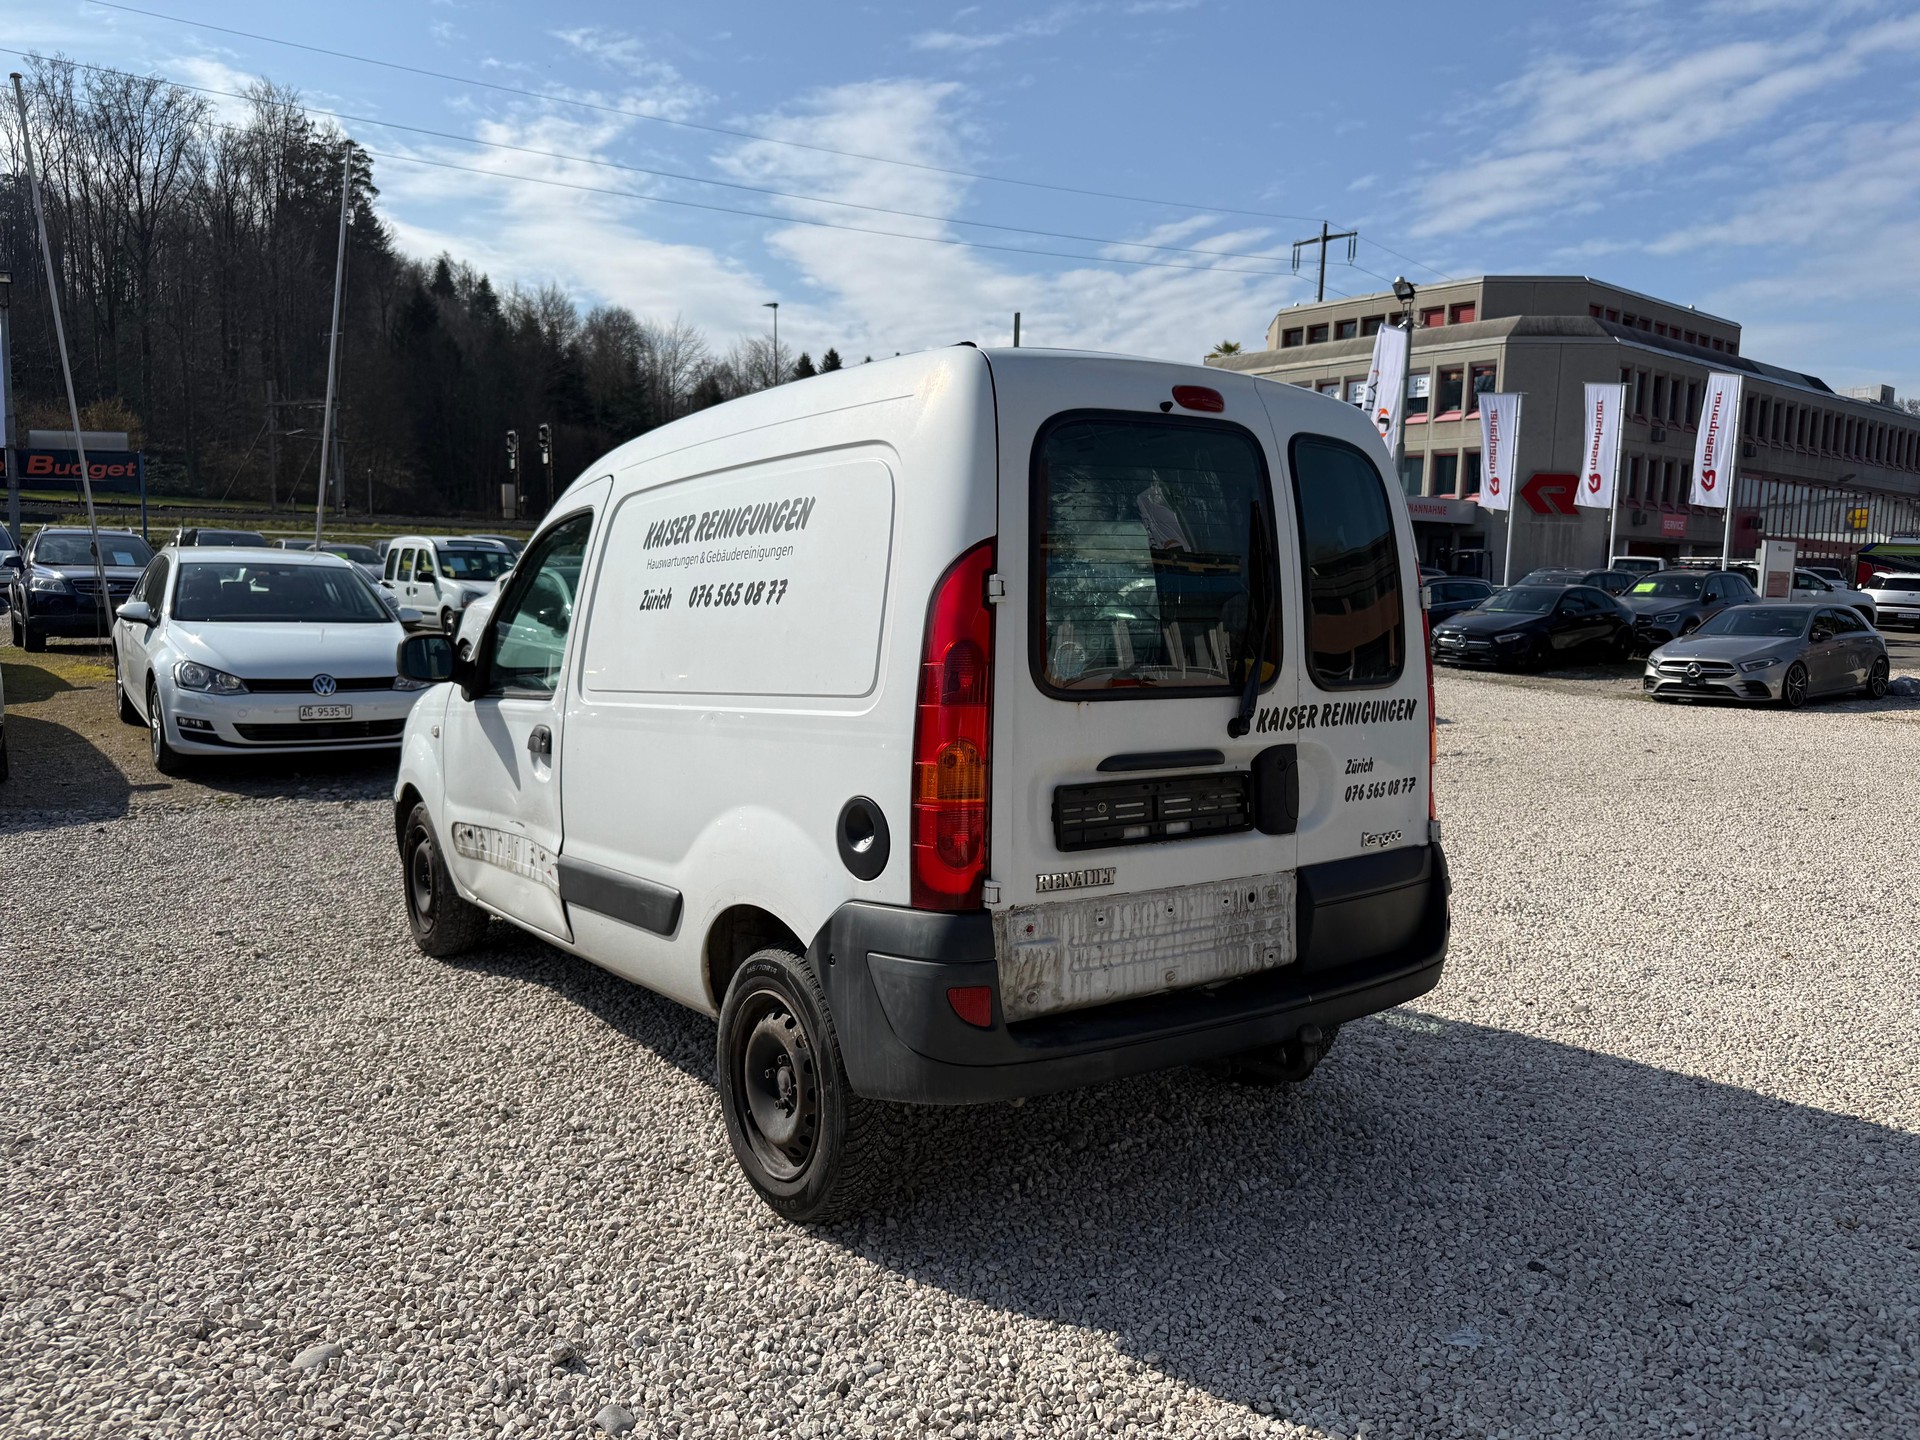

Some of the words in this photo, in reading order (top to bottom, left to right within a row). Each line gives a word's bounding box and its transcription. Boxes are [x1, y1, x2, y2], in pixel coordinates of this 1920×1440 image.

[643, 514, 696, 550] KAISER
[694, 496, 816, 542] REINIGUNGEN
[1664, 520, 1684, 530] SERVICE
[647, 550, 699, 570] Hauswartungen
[699, 551, 705, 564] &
[706, 544, 794, 565] Gebäudereinigungen
[640, 587, 673, 611] Zürich
[688, 584, 713, 608] 076
[714, 582, 743, 607] 565
[745, 580, 766, 606] 08
[766, 579, 788, 605] 77
[1256, 704, 1318, 733] KAISER
[1320, 699, 1417, 727] REINIGUNGEN
[1345, 757, 1373, 775] Zürich
[1345, 783, 1364, 802] 076
[1366, 782, 1386, 801] 565
[1387, 780, 1400, 796] 08
[1401, 777, 1416, 794] 77
[1361, 830, 1403, 847] Kangoo
[1036, 867, 1117, 893] RENAULT
